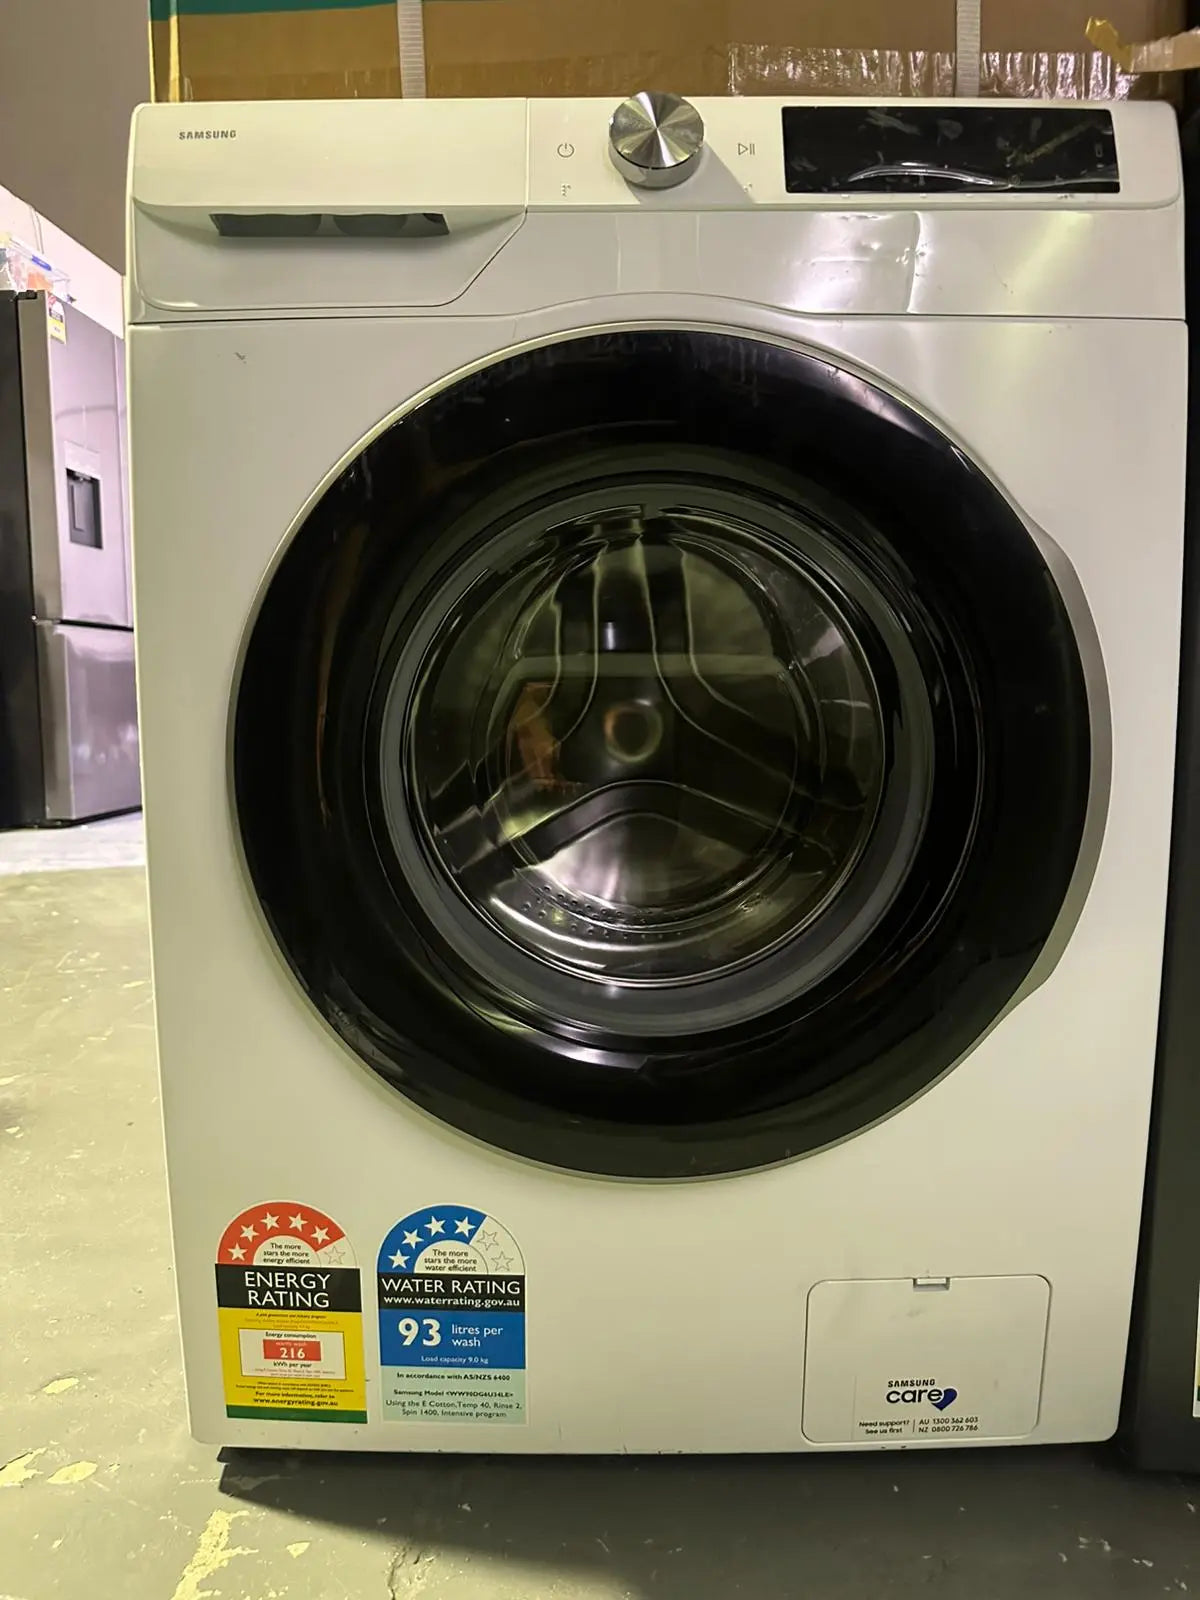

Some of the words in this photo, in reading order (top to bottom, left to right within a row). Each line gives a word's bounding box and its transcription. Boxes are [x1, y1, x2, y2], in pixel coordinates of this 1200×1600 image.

[179, 130, 237, 140] SAMSUNG
[270, 1242, 282, 1250] The
[448, 1264, 476, 1272] efficient
[244, 1271, 331, 1290] ENERGY
[381, 1278, 445, 1293] WATER
[451, 1280, 520, 1294] RATING
[248, 1290, 330, 1308] RATING
[383, 1296, 520, 1308] www.waterrating.gov.au
[398, 1317, 442, 1347] 93
[451, 1324, 480, 1335] litres
[483, 1326, 504, 1338] per
[451, 1337, 481, 1347] wash
[280, 1348, 306, 1359] 216
[440, 1356, 466, 1364] capacity
[888, 1378, 936, 1388] SAMSUNG
[394, 1388, 422, 1396] Samsung
[886, 1388, 943, 1404] care
[386, 1400, 406, 1408] Using
[402, 1408, 418, 1416] Spin
[878, 1420, 910, 1428] support?
